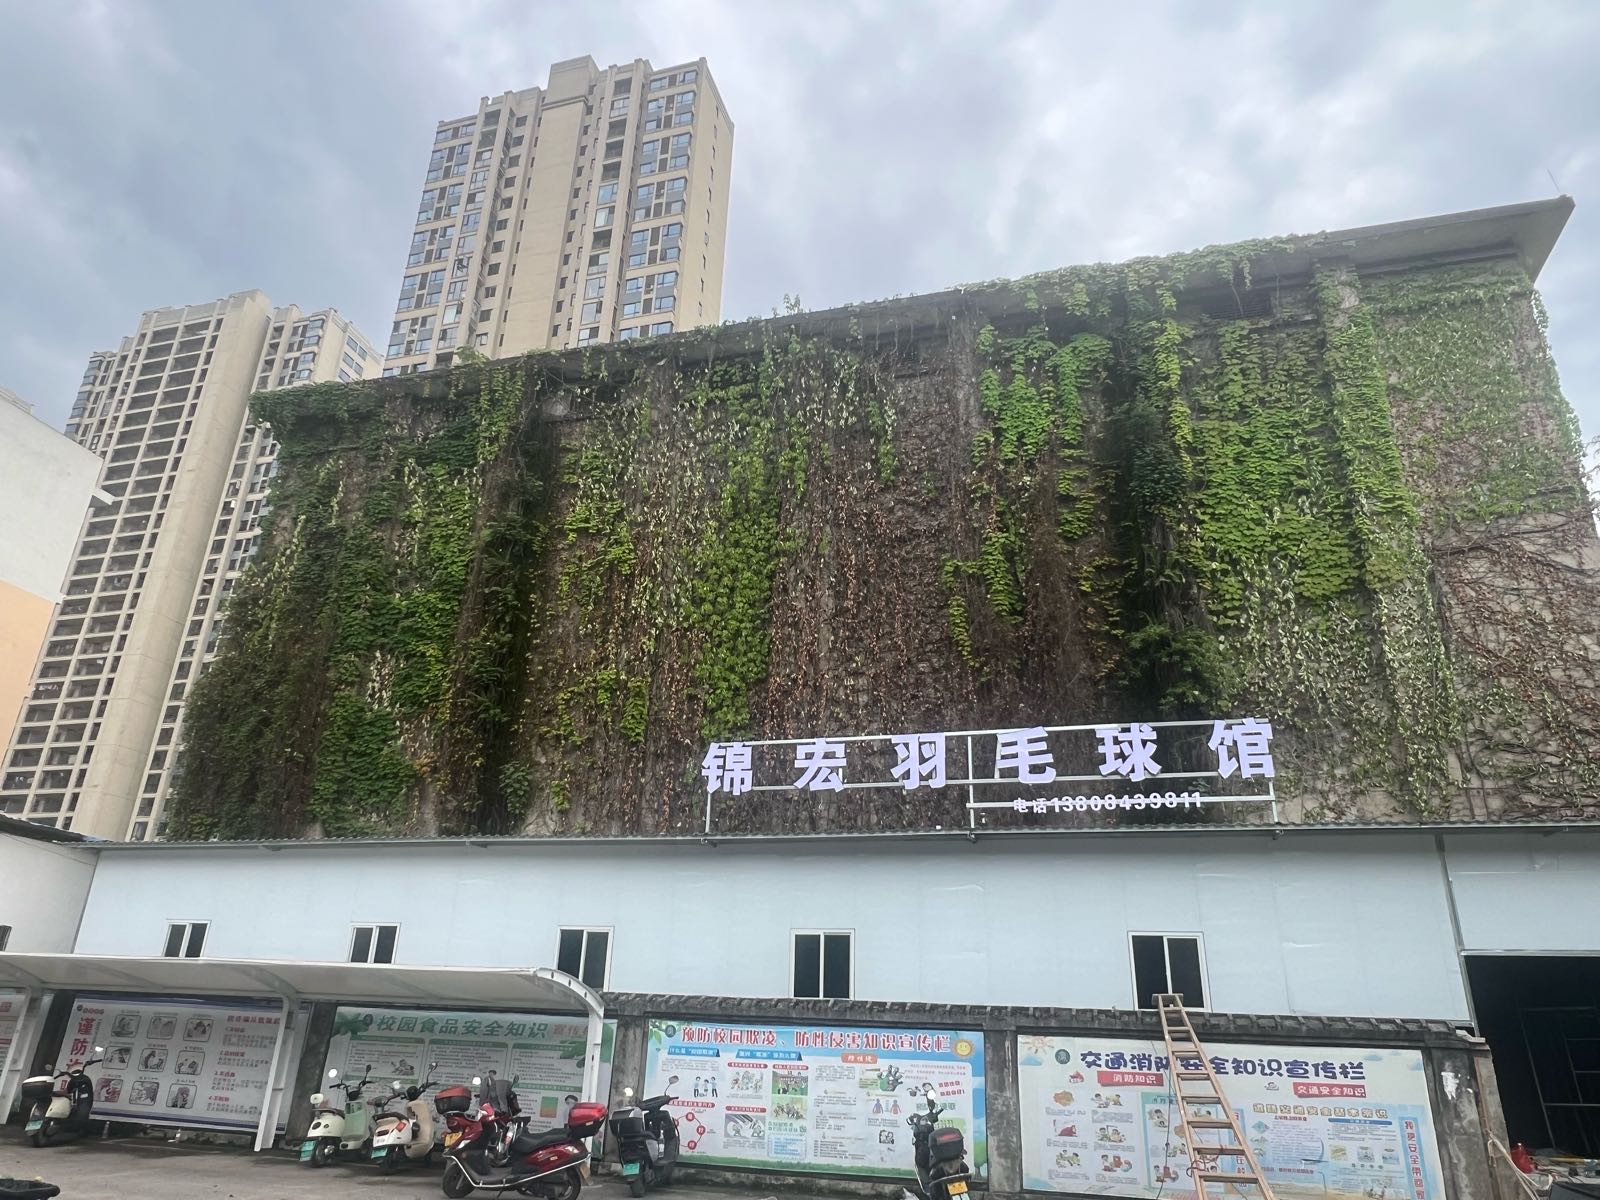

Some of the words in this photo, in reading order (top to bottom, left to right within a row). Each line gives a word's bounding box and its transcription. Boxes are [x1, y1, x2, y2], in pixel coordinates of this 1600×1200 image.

[701, 718, 1274, 796] 锦宏羽毛球馆
[376, 1015, 548, 1039] 校园食品安全知识
[1113, 1074, 1157, 1084] 消防知识
[1297, 1085, 1366, 1097] 交通安全知识
